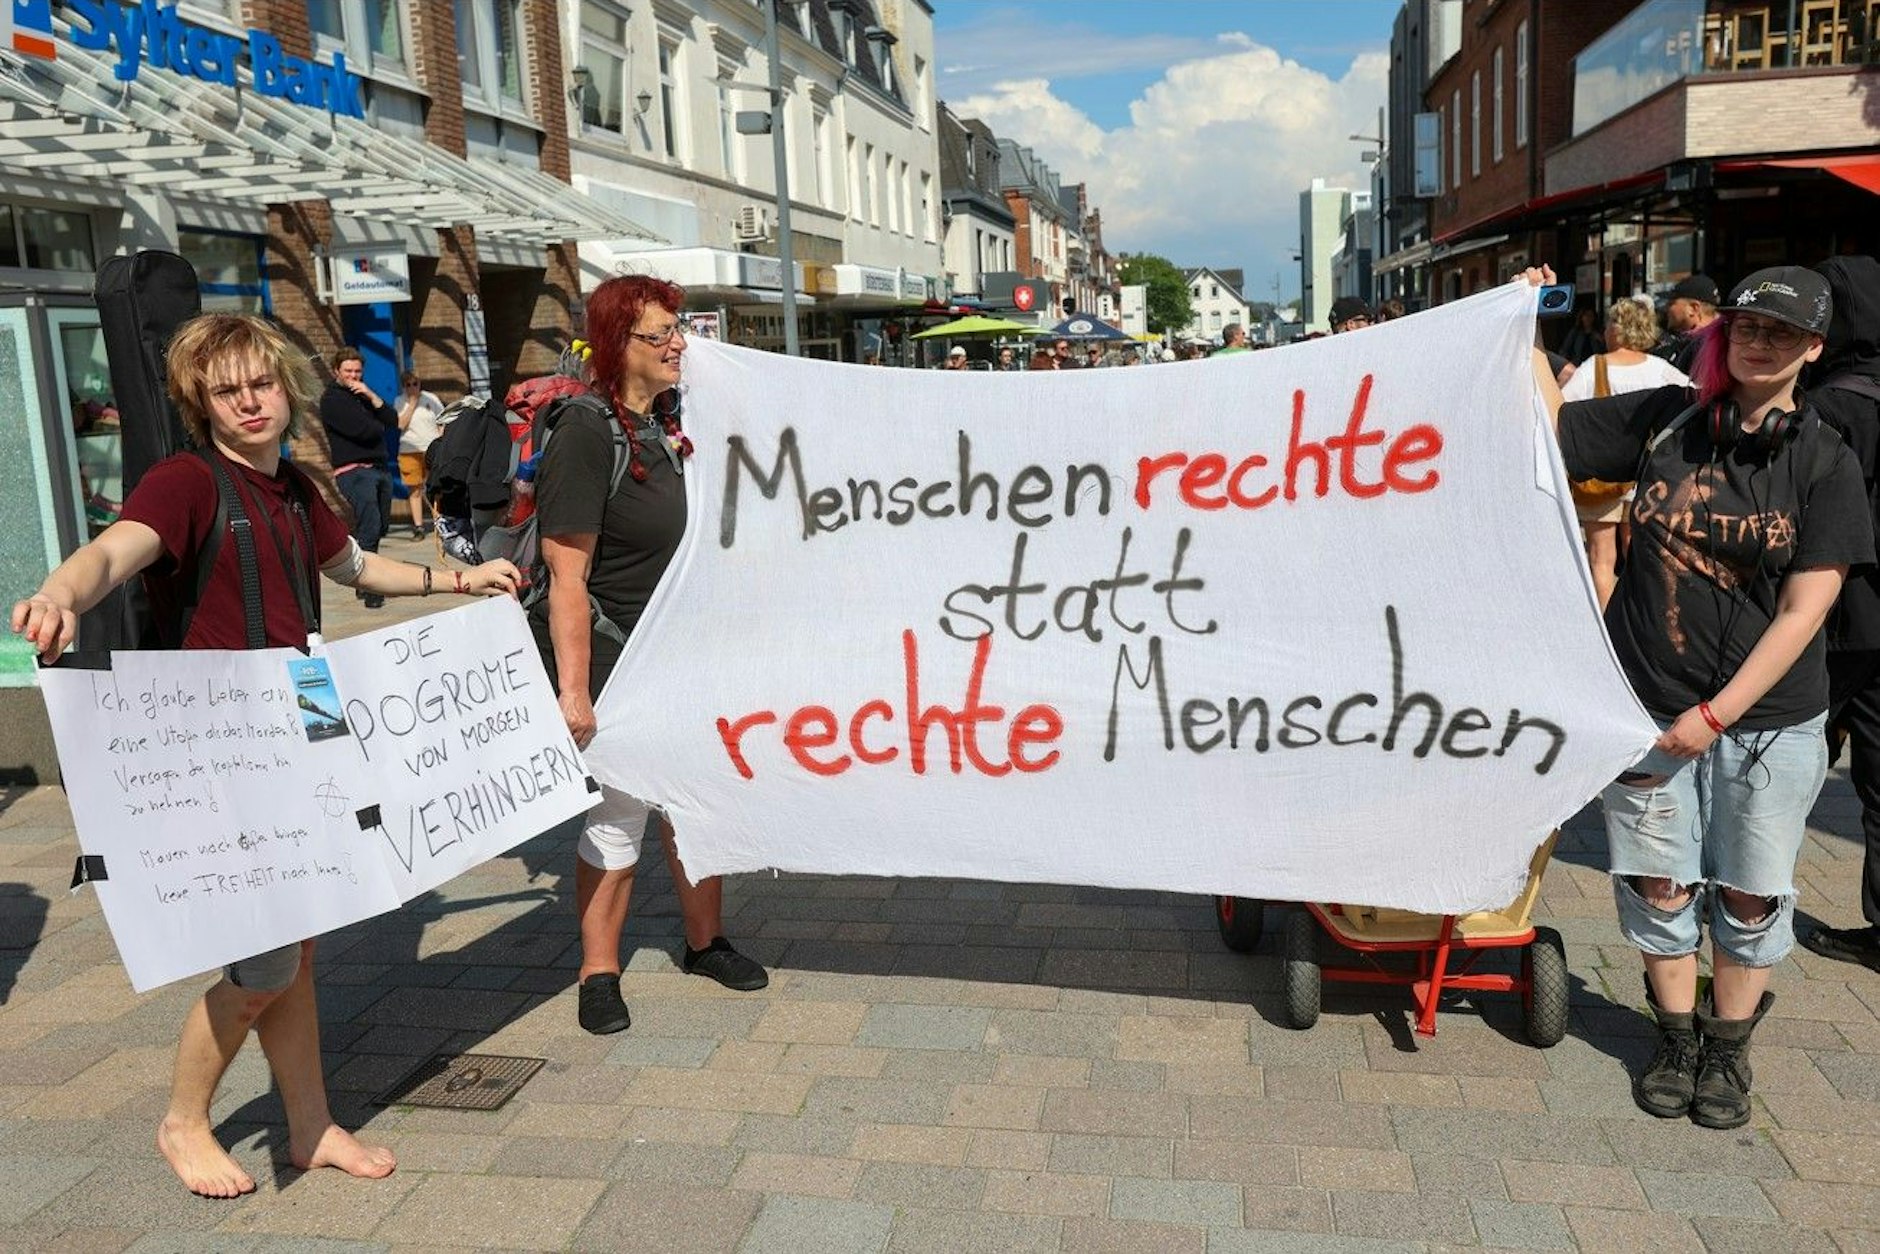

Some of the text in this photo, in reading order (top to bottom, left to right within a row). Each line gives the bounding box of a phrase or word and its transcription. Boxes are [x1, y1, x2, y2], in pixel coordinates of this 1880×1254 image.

[70, 0, 364, 119] Sylter Bank
[343, 279, 405, 291] Geldautomat
[466, 293, 480, 311] 18
[938, 526, 1217, 643] statt
[91, 672, 130, 713] Ich
[140, 678, 196, 720] glaube
[261, 688, 290, 704] an
[346, 648, 530, 761] POGROME
[715, 605, 1566, 779] rechte Menschen
[107, 736, 149, 754] eine
[404, 705, 531, 776] VON MORGEN
